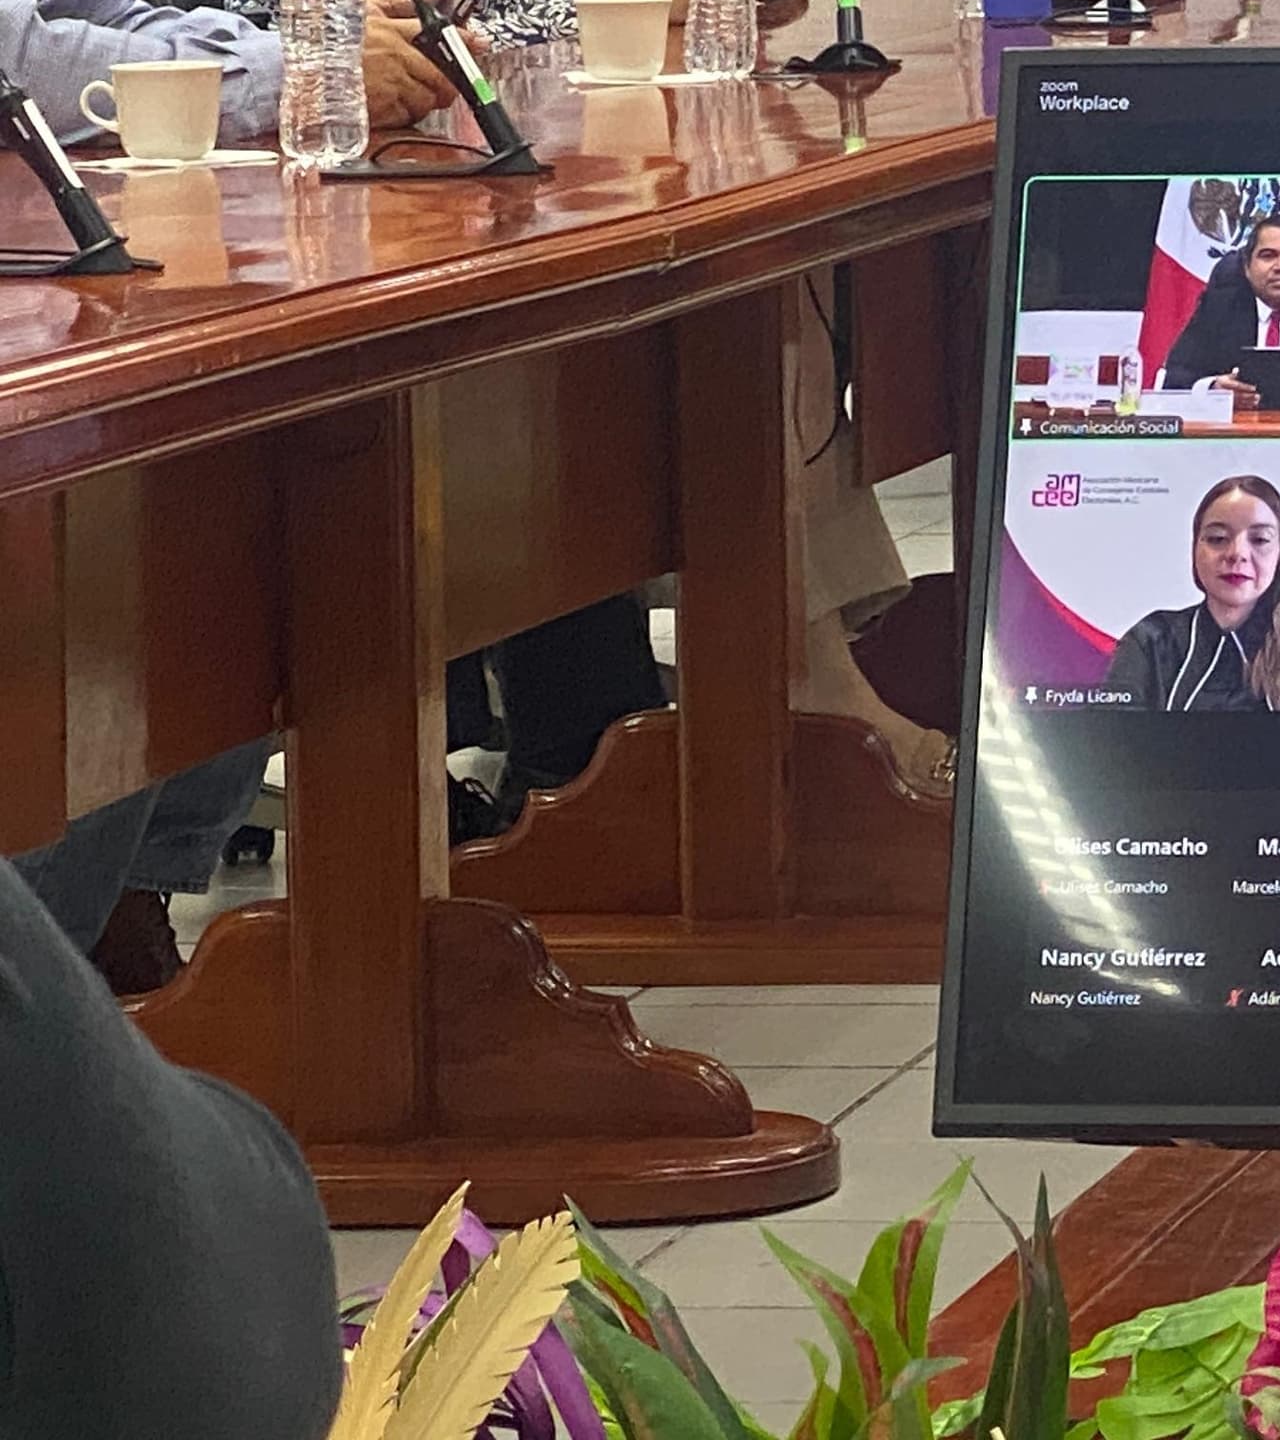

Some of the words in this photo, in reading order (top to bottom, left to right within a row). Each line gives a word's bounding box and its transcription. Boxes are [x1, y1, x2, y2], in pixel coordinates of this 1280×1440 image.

[1040, 80, 1079, 92] zoom
[1039, 95, 1130, 113] Workplace
[1040, 420, 1136, 435] Comunicación
[1139, 420, 1179, 435] Social
[1045, 688, 1084, 706] Fryda
[1087, 688, 1132, 704] Licano
[1116, 837, 1208, 857] Camacho
[1041, 948, 1101, 971] Nancy
[1110, 948, 1206, 968] Gutiérrez
